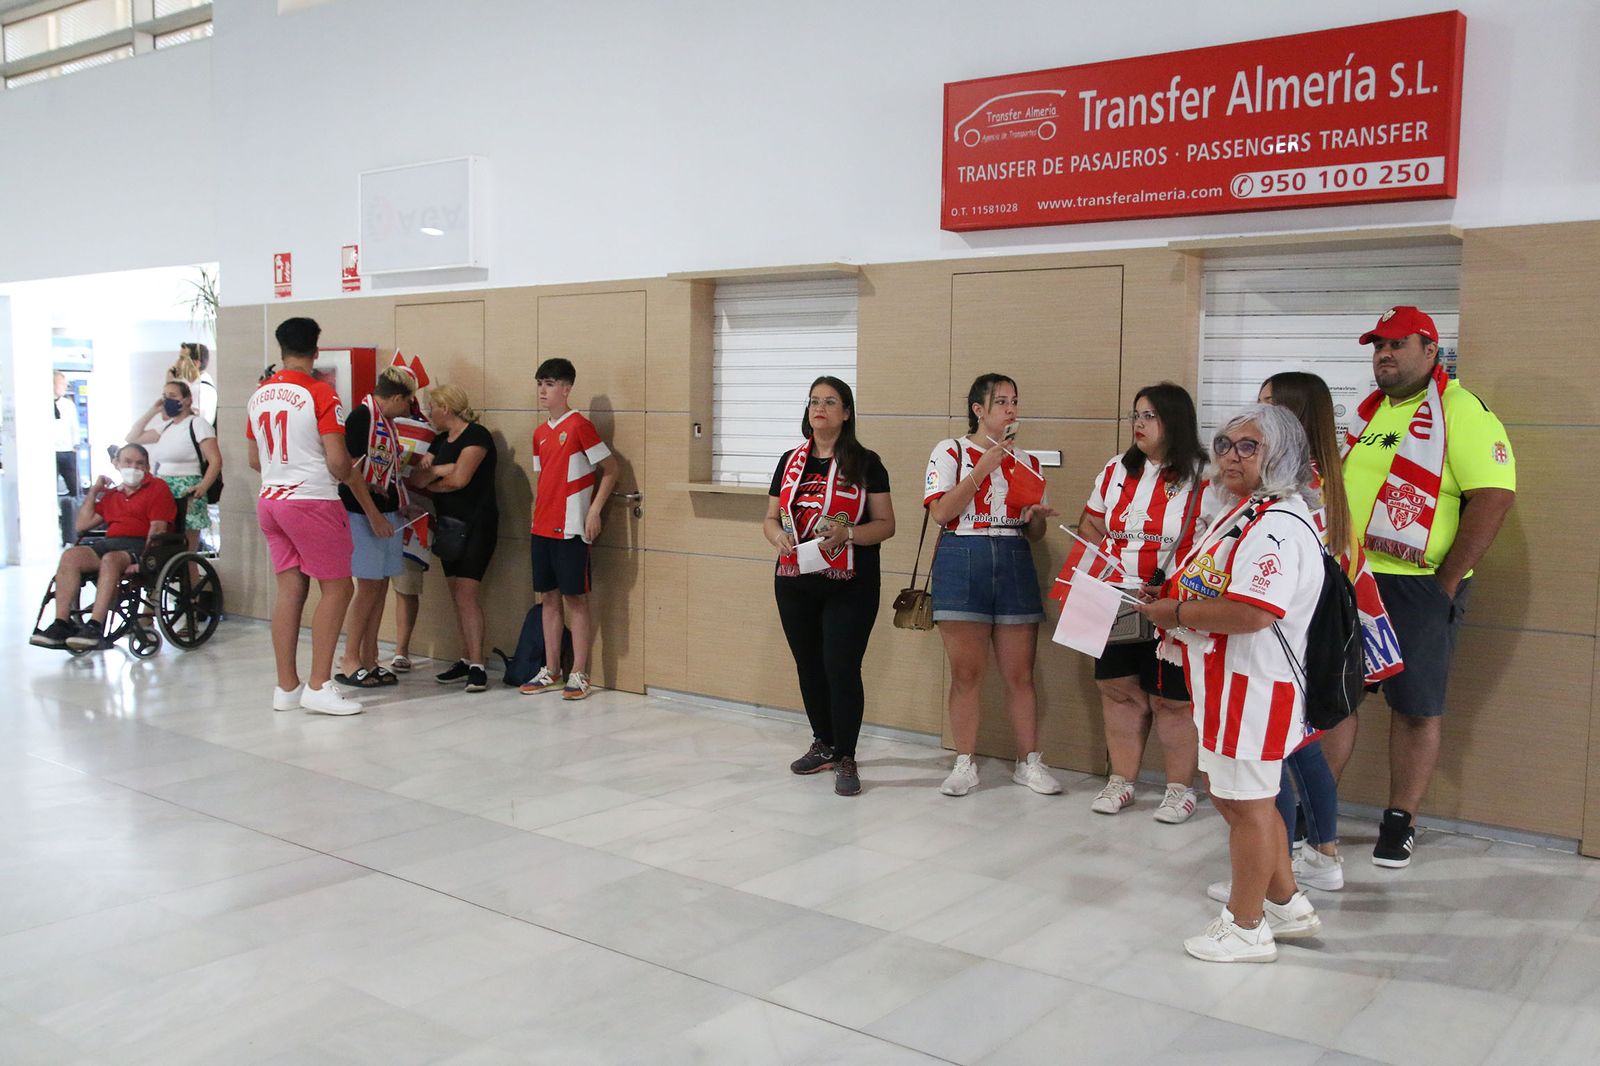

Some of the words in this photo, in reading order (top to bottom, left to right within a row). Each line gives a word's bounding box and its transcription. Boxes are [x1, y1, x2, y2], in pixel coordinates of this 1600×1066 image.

[1078, 75, 1216, 132] Transfer
[1226, 52, 1377, 117] Almería
[1390, 59, 1439, 98] S.L.
[987, 108, 1022, 122] Transfer
[1025, 103, 1056, 118] Almería
[958, 159, 1036, 183] TRANSFER
[1043, 157, 1063, 175] DE
[1070, 146, 1168, 173] PASAJEROS
[1187, 133, 1312, 163] PASSENGERS
[1319, 121, 1429, 151] TRANSFER
[1260, 170, 1307, 194] 950
[1318, 166, 1368, 189] 100
[1380, 161, 1431, 184] 250
[1037, 185, 1223, 210] www.transferalmeria.com
[951, 206, 968, 217] O.T.
[971, 203, 1018, 215] 11581028
[277, 388, 306, 411] SOUSA
[258, 410, 289, 464] 11
[1357, 432, 1383, 446] cis
[964, 513, 998, 523] Arabian
[1137, 532, 1174, 544] Centres
